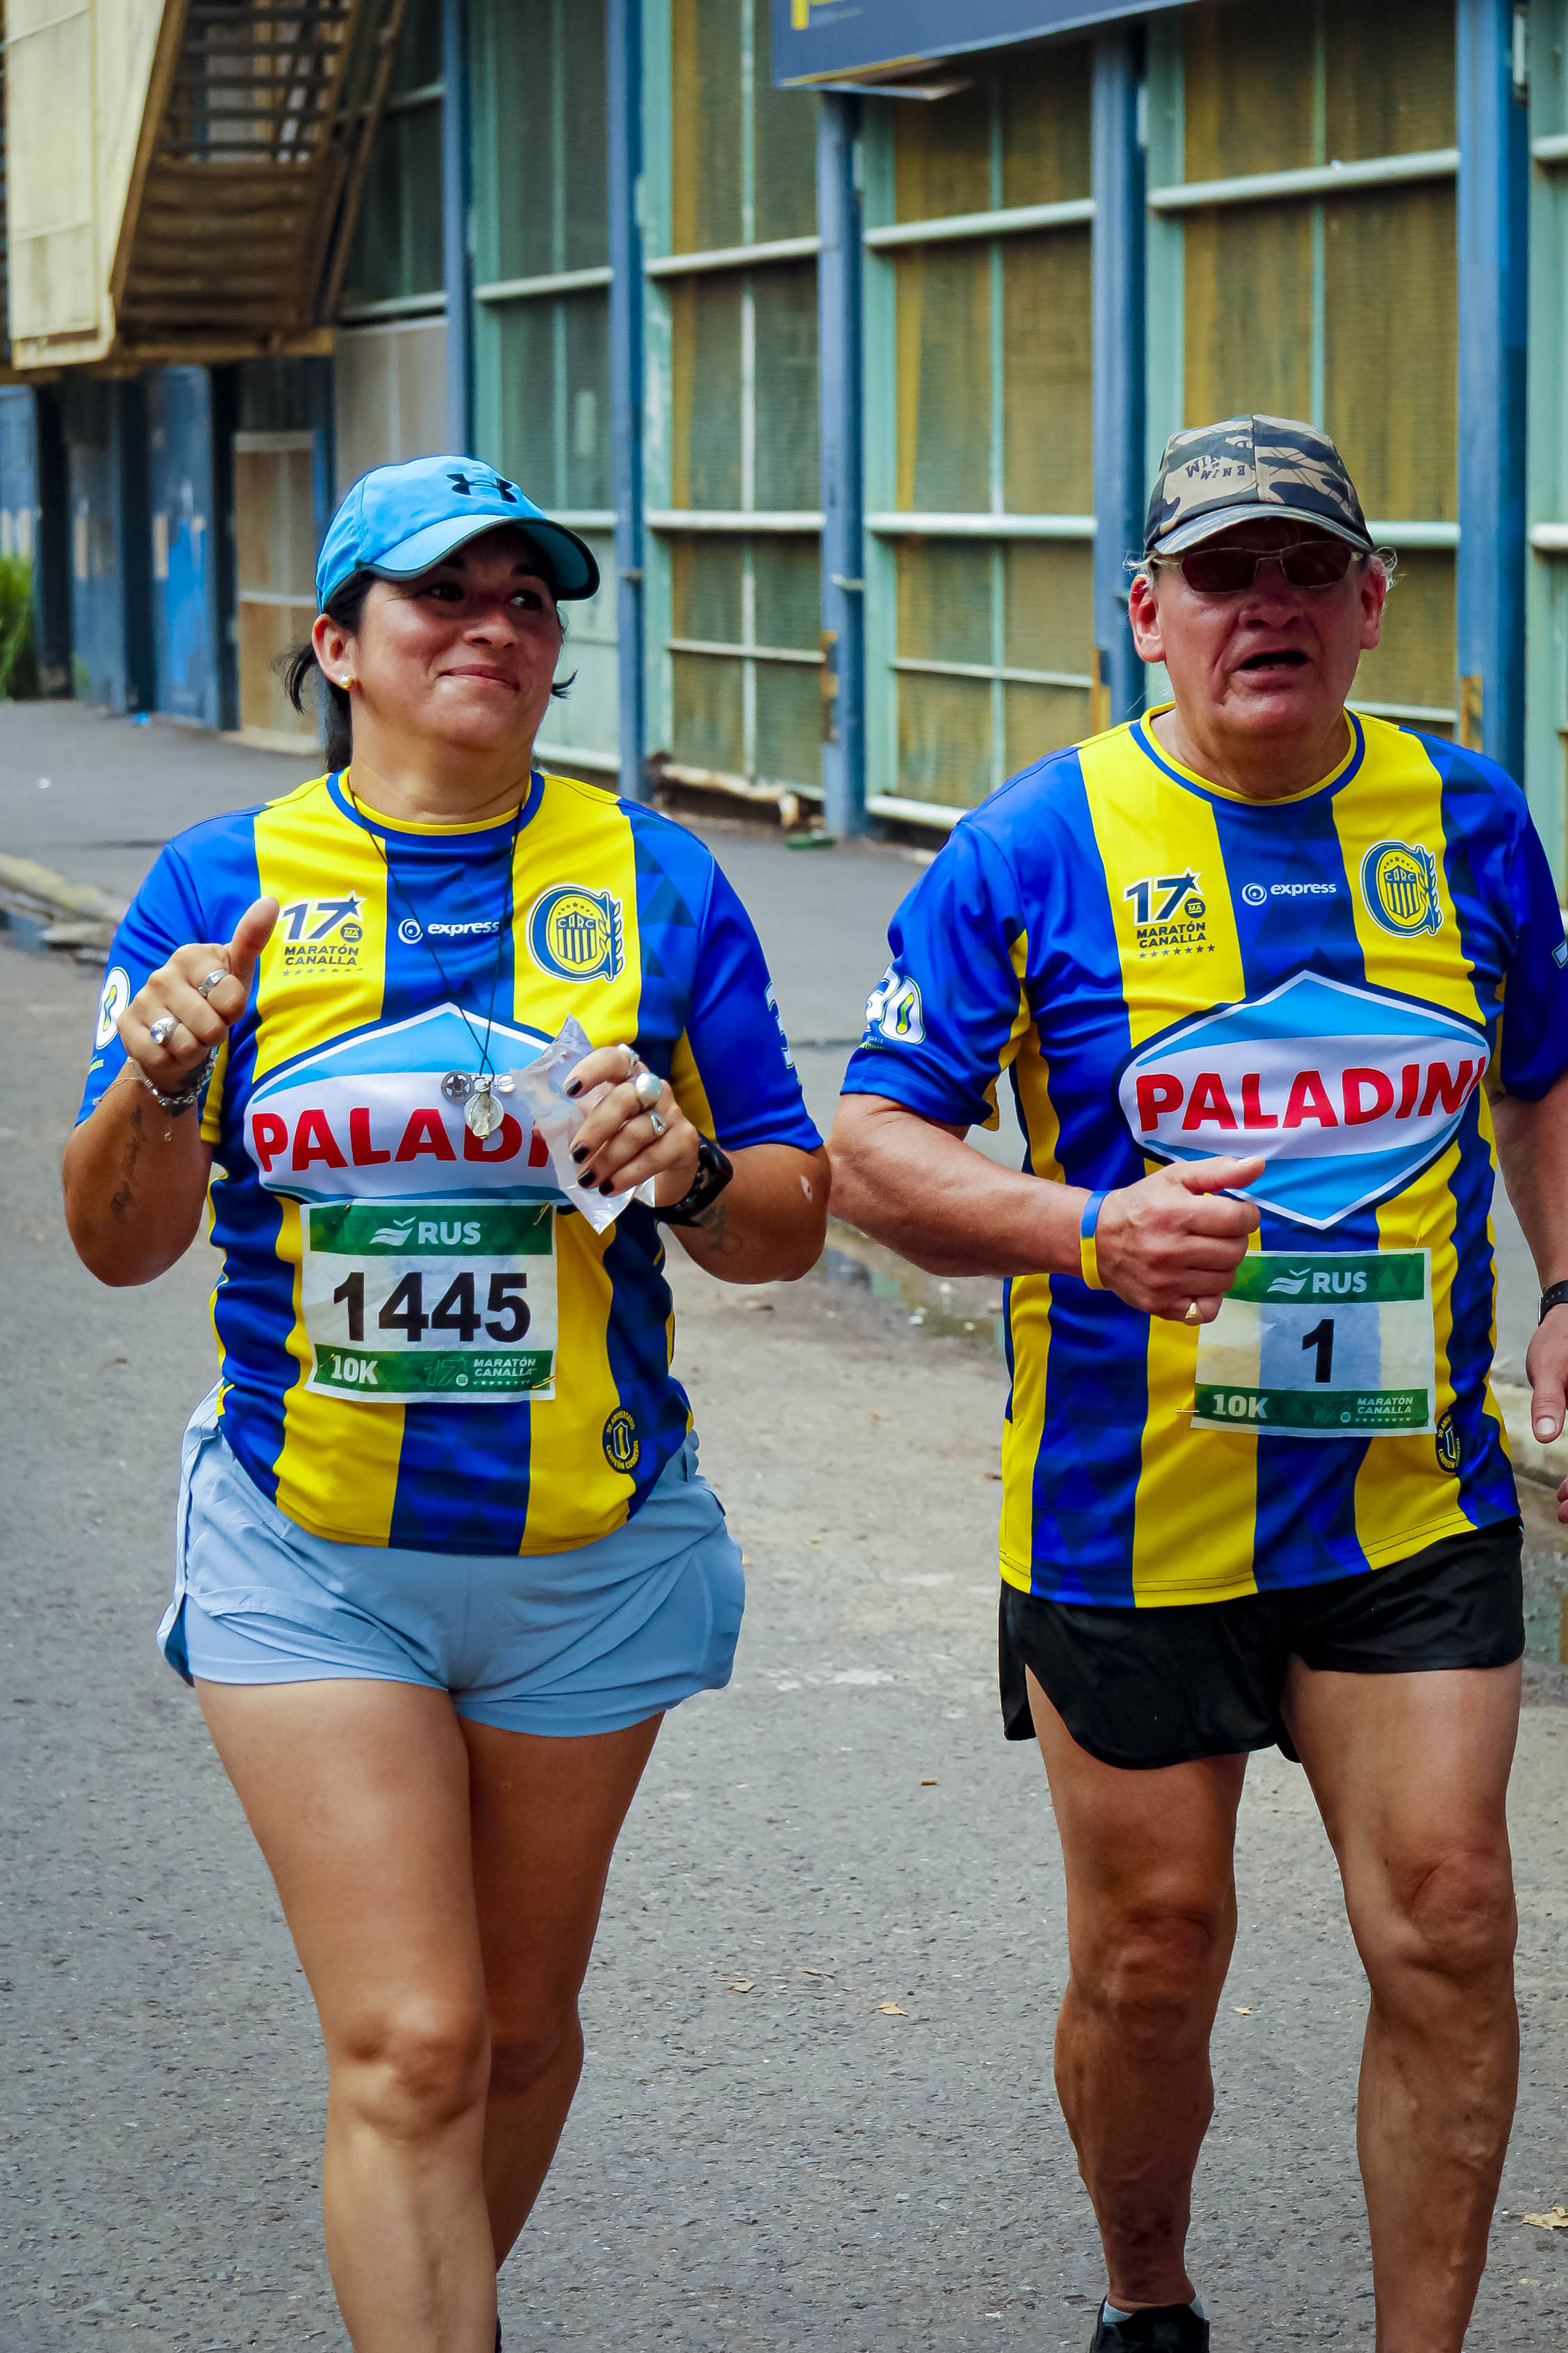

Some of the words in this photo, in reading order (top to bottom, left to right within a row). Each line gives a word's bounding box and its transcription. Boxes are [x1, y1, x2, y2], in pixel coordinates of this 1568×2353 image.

[1385, 867, 1415, 881] CARC
[1123, 869, 1202, 926] 17
[1270, 883, 1337, 896] express
[279, 892, 364, 942] 17
[558, 915, 594, 928] CARC
[427, 921, 500, 937] express
[1137, 921, 1205, 938] MARATÓN
[1139, 933, 1206, 949] CANALLA
[284, 944, 359, 956] MARATÓN
[286, 956, 356, 966] CANALLA
[252, 1107, 550, 1172] PALADI
[418, 1221, 481, 1245] RUS
[1312, 1271, 1367, 1294] RUS
[333, 1271, 531, 1343] 1445
[1301, 1318, 1335, 1383] 1
[331, 1355, 378, 1385] 10K
[472, 1356, 536, 1368] MARATÓN
[1212, 1394, 1269, 1418] 10K
[1357, 1395, 1413, 1406] MARATÓN
[1357, 1406, 1412, 1414] CANALLA
